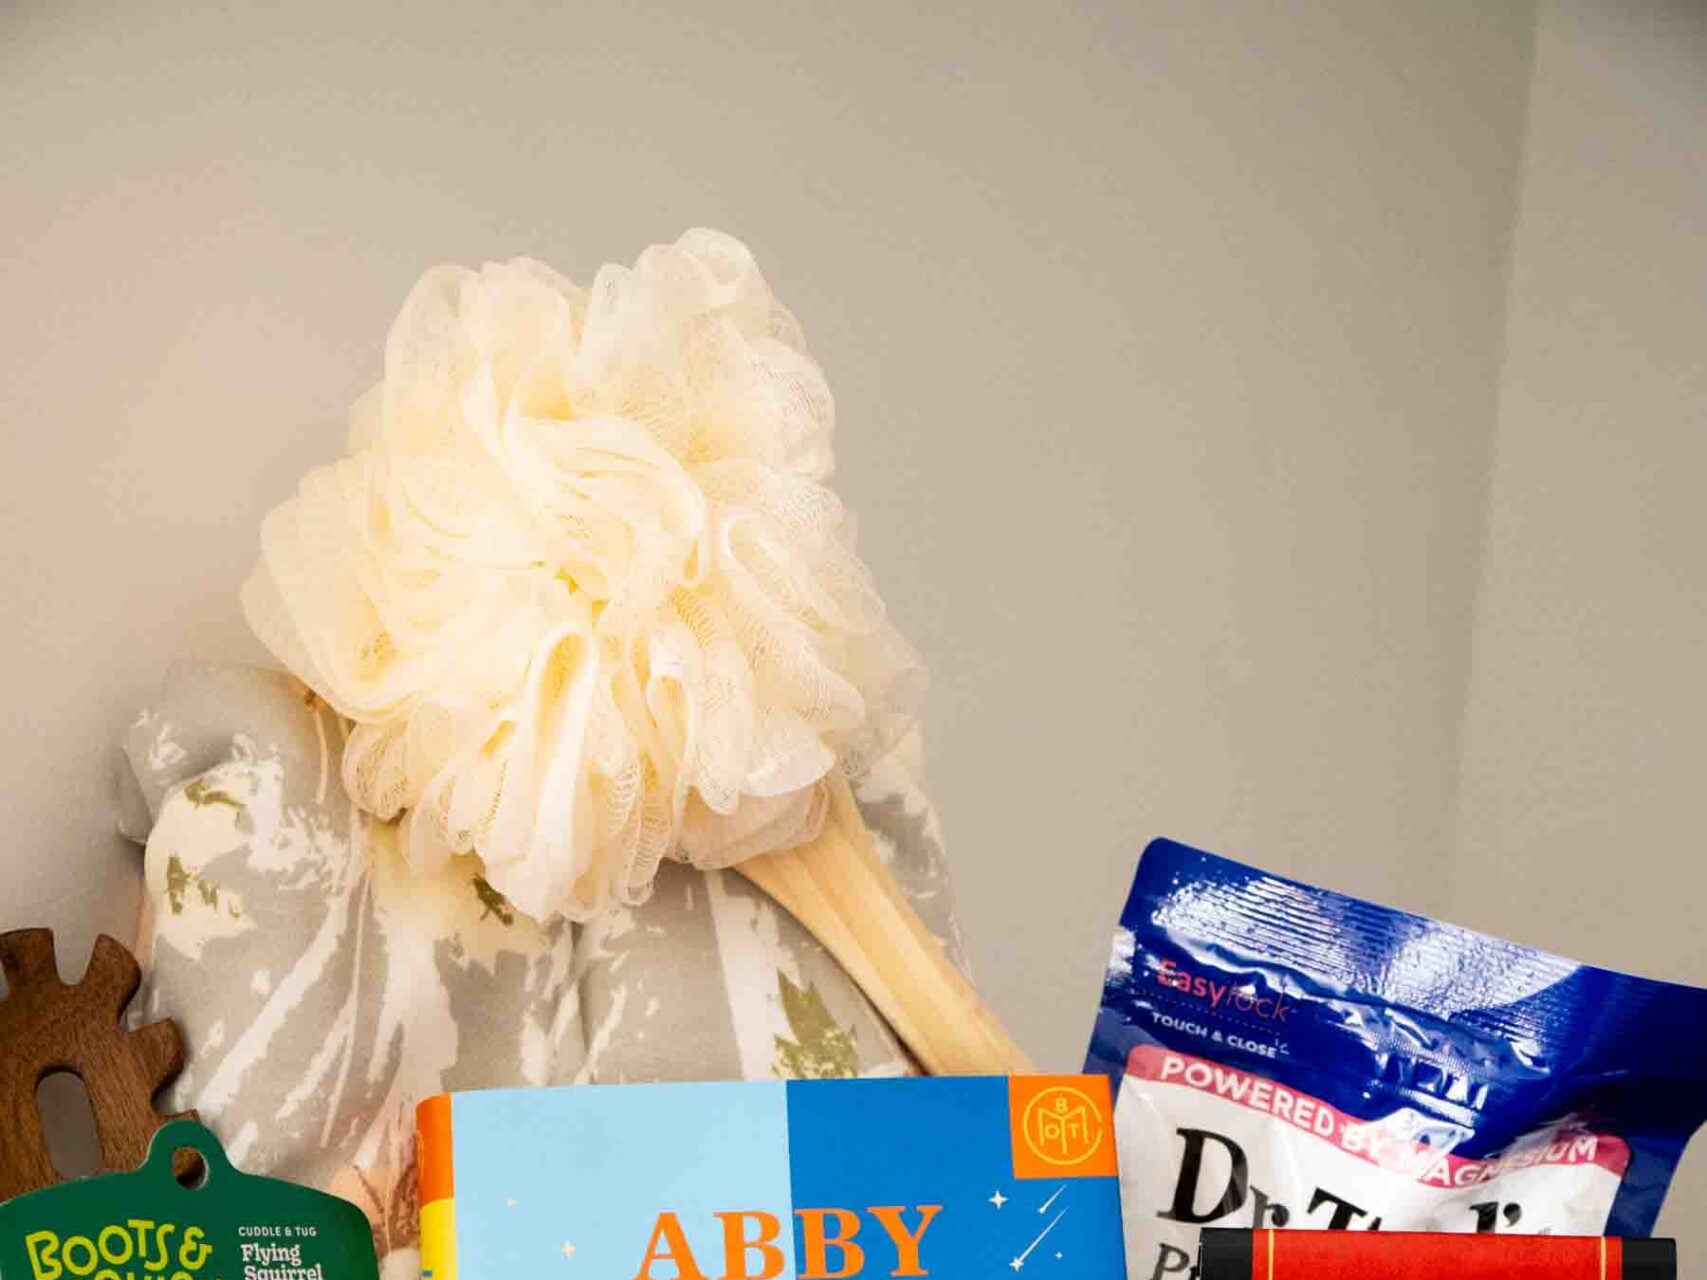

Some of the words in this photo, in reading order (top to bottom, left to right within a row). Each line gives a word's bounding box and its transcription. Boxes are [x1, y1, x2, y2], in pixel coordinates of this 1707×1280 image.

[1152, 1011, 1208, 1038] TOUCH
[1211, 1029, 1223, 1042] &
[1226, 1034, 1278, 1059] CLOSE
[1160, 1055, 1336, 1138] POWERED
[1400, 1134, 1599, 1189] AGNSIUM
[1156, 1127, 1290, 1229] Dr
[238, 1225, 282, 1237] CUDDLE
[285, 1226, 292, 1237] &
[295, 1226, 317, 1237] TUG
[240, 1242, 302, 1267] Flying
